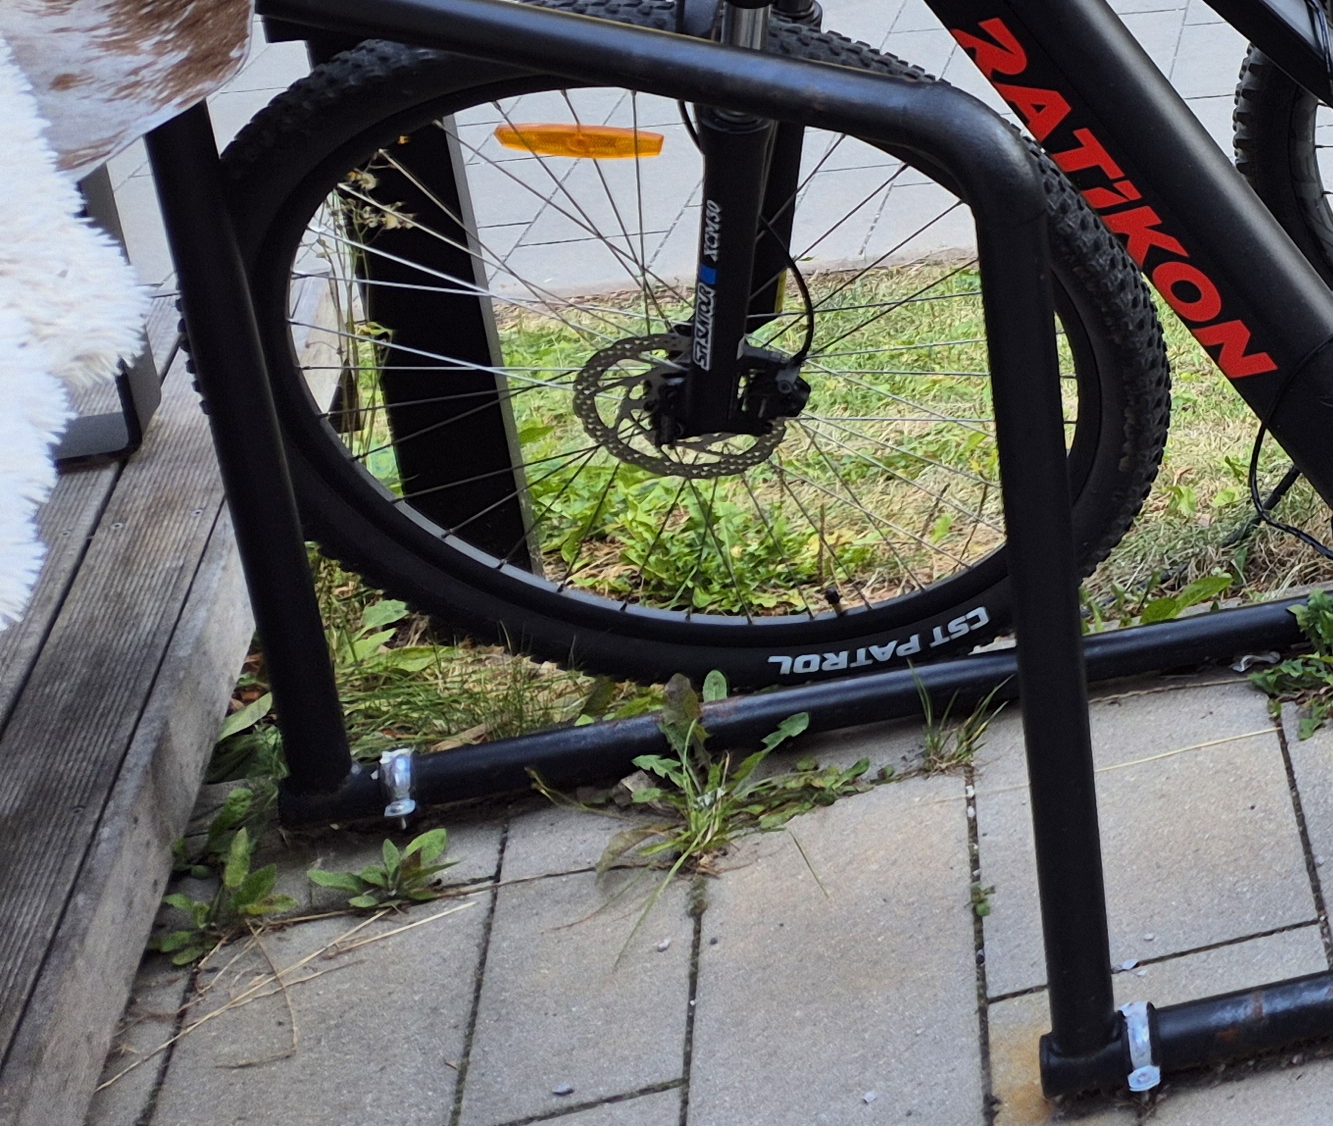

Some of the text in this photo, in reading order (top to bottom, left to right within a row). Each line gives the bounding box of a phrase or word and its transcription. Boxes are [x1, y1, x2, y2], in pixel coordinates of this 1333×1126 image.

[952, 17, 1278, 378] RATIKON
[767, 606, 990, 675] CST PATROL
